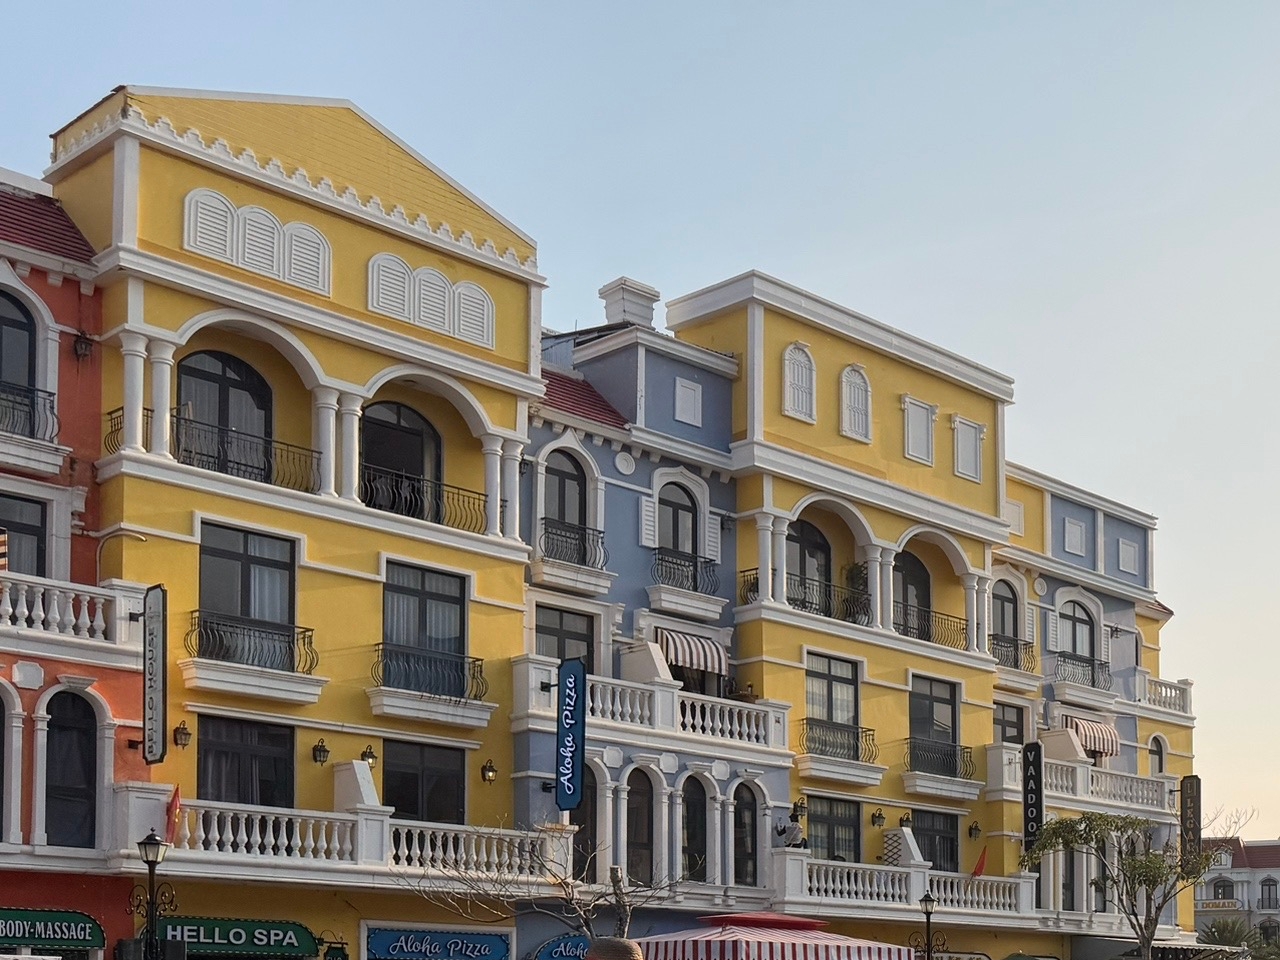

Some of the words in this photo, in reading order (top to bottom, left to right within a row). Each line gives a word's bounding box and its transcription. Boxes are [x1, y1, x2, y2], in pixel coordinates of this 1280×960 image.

[562, 674, 576, 728] Pizza
[559, 733, 574, 795] Aloha
[1027, 751, 1037, 832] VAADOO
[1201, 901, 1237, 909] DOMAIN
[0, 920, 93, 940] BODY-MASSAGE
[166, 925, 247, 944] HELLO
[253, 928, 299, 947] SPA
[389, 935, 442, 957] Aloha
[446, 938, 492, 958] Pizza
